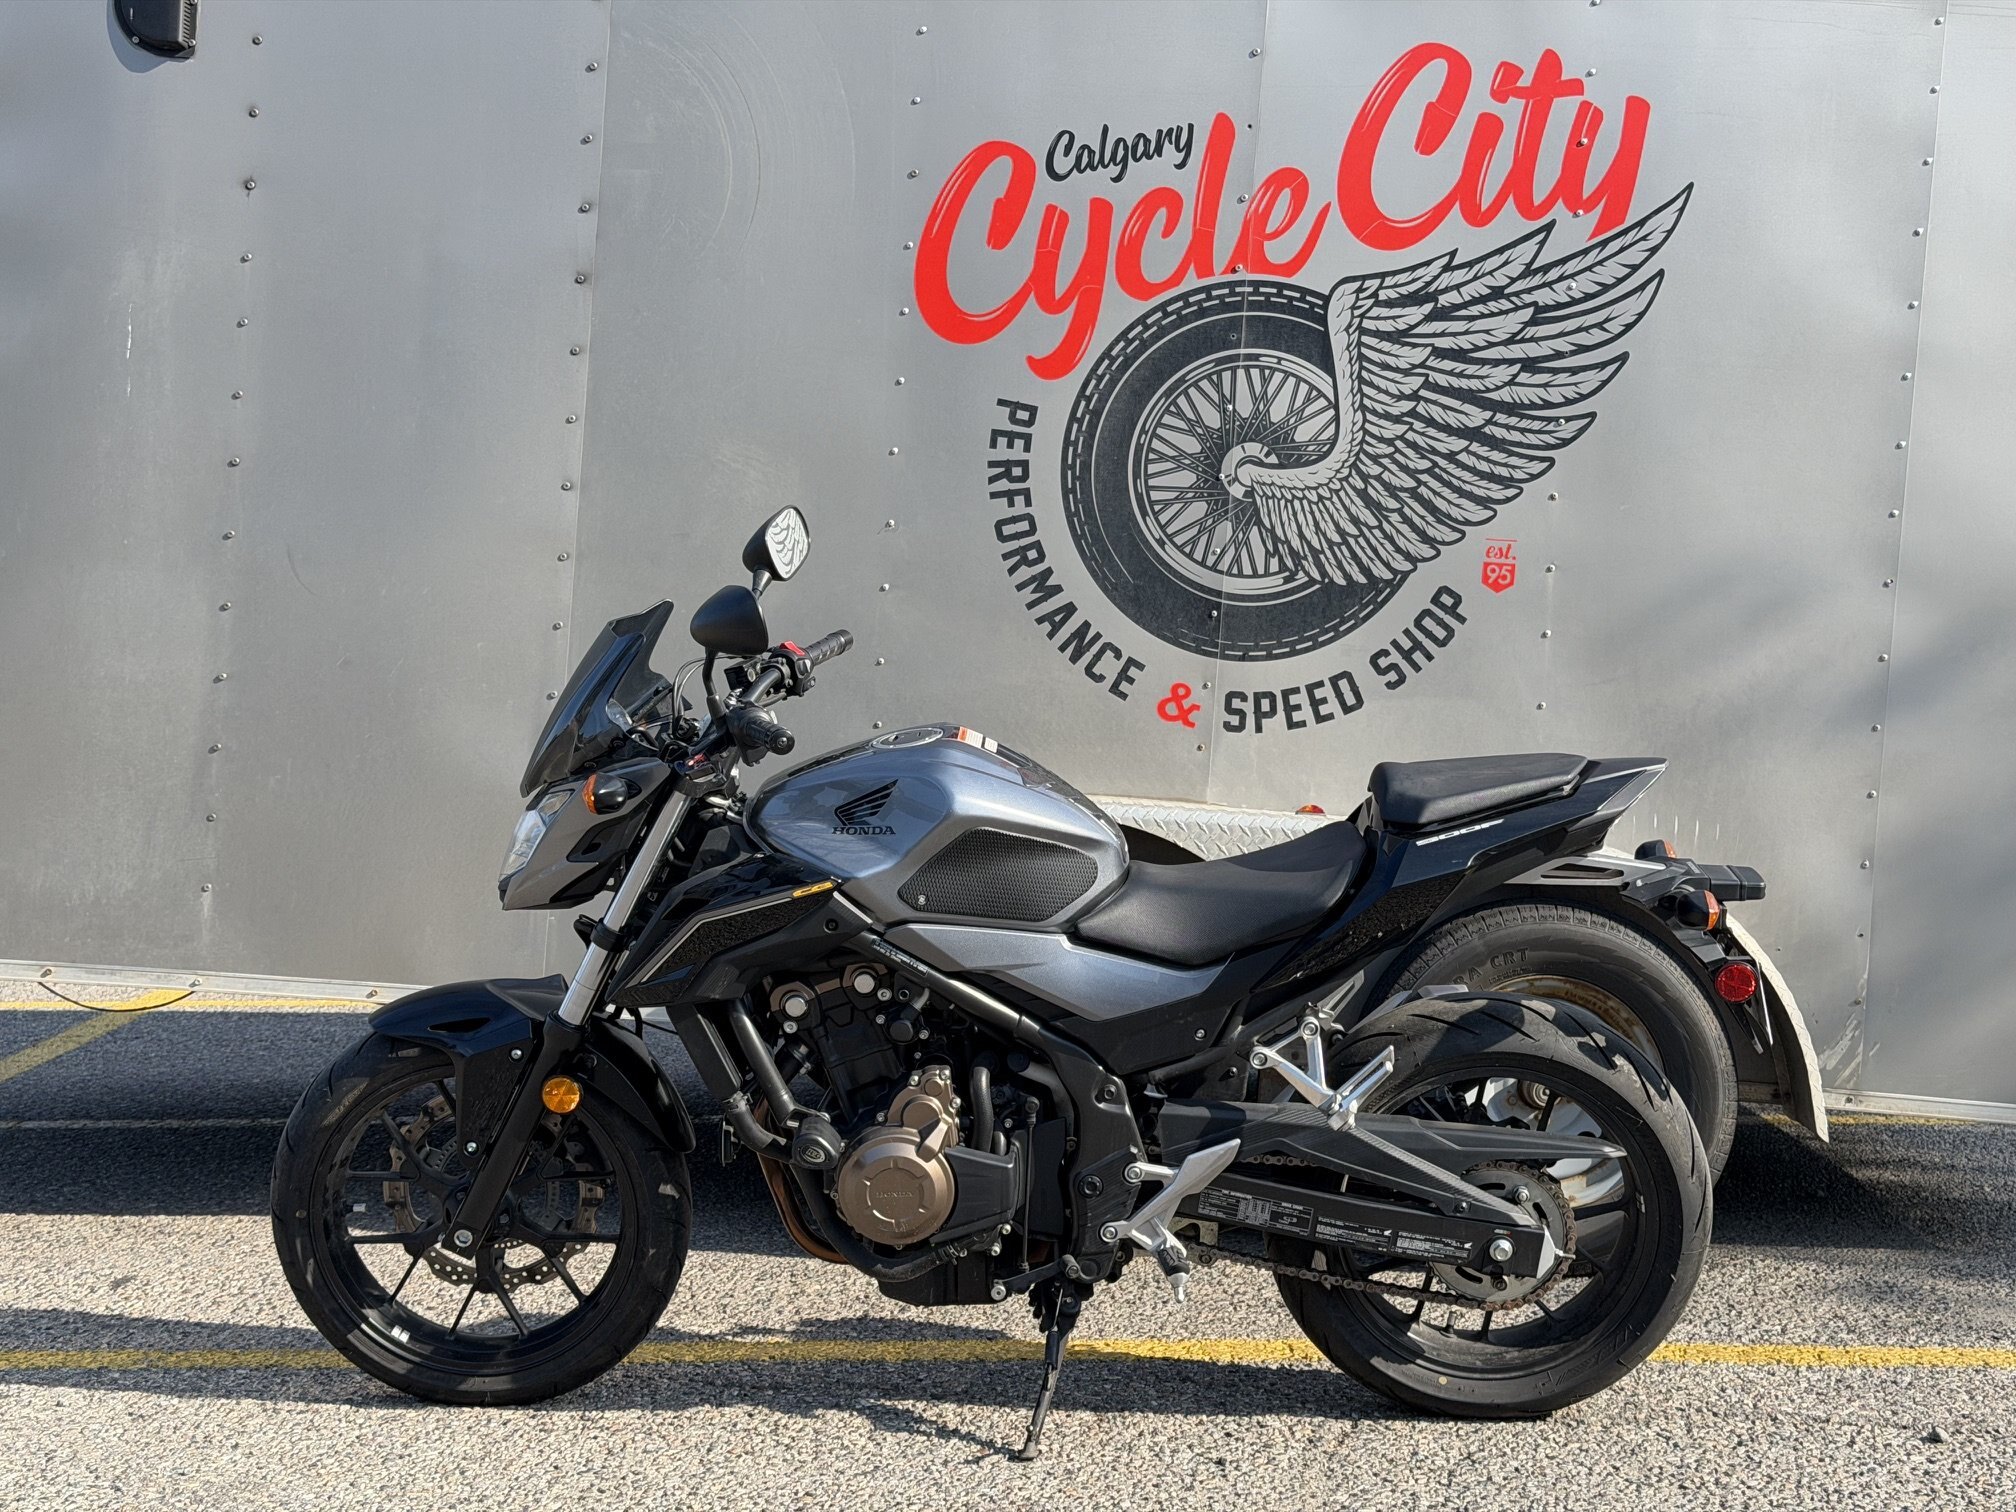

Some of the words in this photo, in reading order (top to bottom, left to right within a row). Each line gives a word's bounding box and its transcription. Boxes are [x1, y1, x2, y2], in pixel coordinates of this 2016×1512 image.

[1046, 121, 1195, 184] Calgary
[914, 112, 1332, 381] Cycle
[1336, 42, 1651, 252] City
[1485, 543, 1517, 561] est.
[987, 398, 1146, 702] PERFORMANCE
[1156, 682, 1201, 729] &
[1222, 670, 1365, 734] SPEED
[1369, 585, 1468, 691] SHOP
[1486, 564, 1512, 585] 95
[832, 826, 897, 836] HONDA
[1489, 947, 1529, 969] CRT
